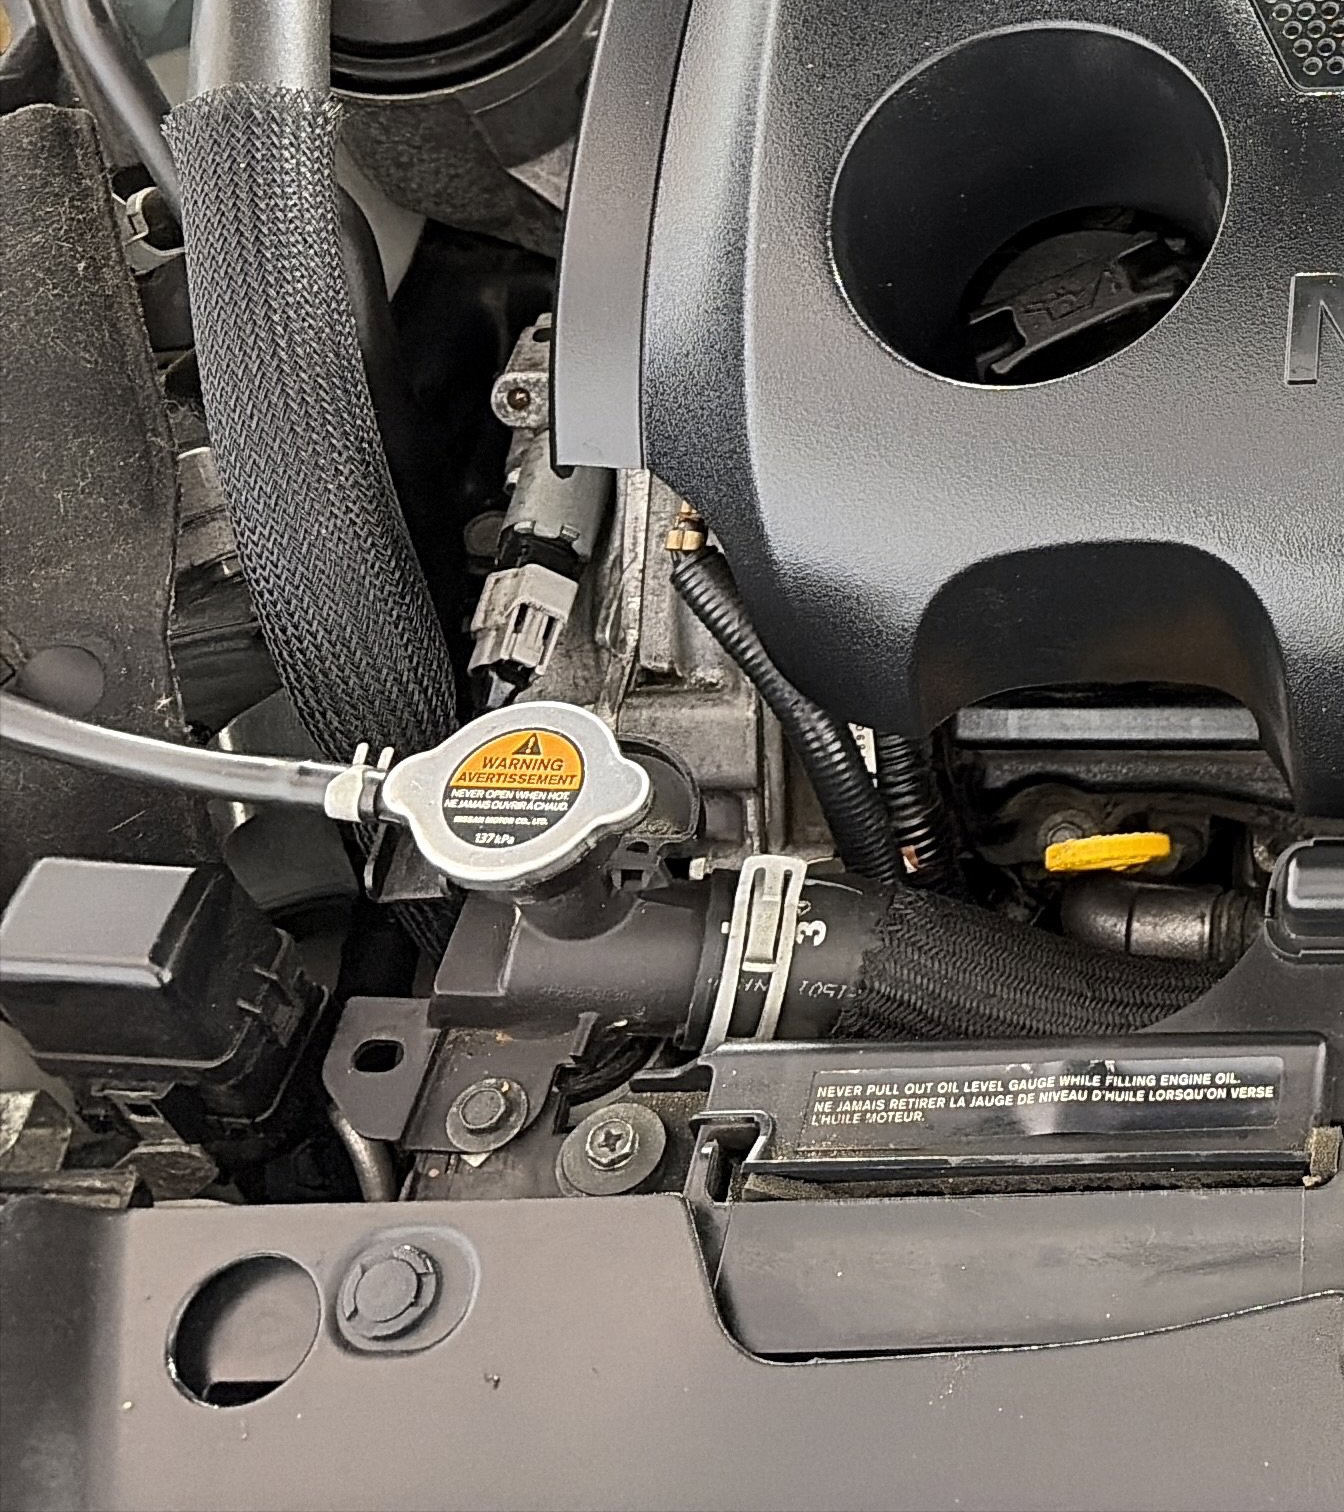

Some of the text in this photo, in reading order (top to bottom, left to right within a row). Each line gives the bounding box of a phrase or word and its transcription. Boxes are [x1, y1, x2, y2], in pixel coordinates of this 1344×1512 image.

[482, 757, 563, 771] WARNING
[457, 772, 577, 785] AVERTISSEMENT
[451, 789, 569, 800] NEVER OPEN WHEN HOT.
[444, 799, 458, 809] NE
[458, 800, 491, 809] JAMAIS
[492, 801, 526, 810] OUVRIR
[533, 801, 568, 811] CHAUD.
[475, 833, 515, 844] 137 kPa
[817, 1072, 1241, 1097] NEVER PULL OUT OIL LEVEL GAUGE WHILE FILLING ENGINE OIL.
[814, 1086, 1274, 1112] NE JAMAIS RETIRER LA JAUGE DE NIVEAU D'HUILE LORSQU'ON VERSE
[811, 1111, 924, 1126] L'HUILE MOTEUR.
